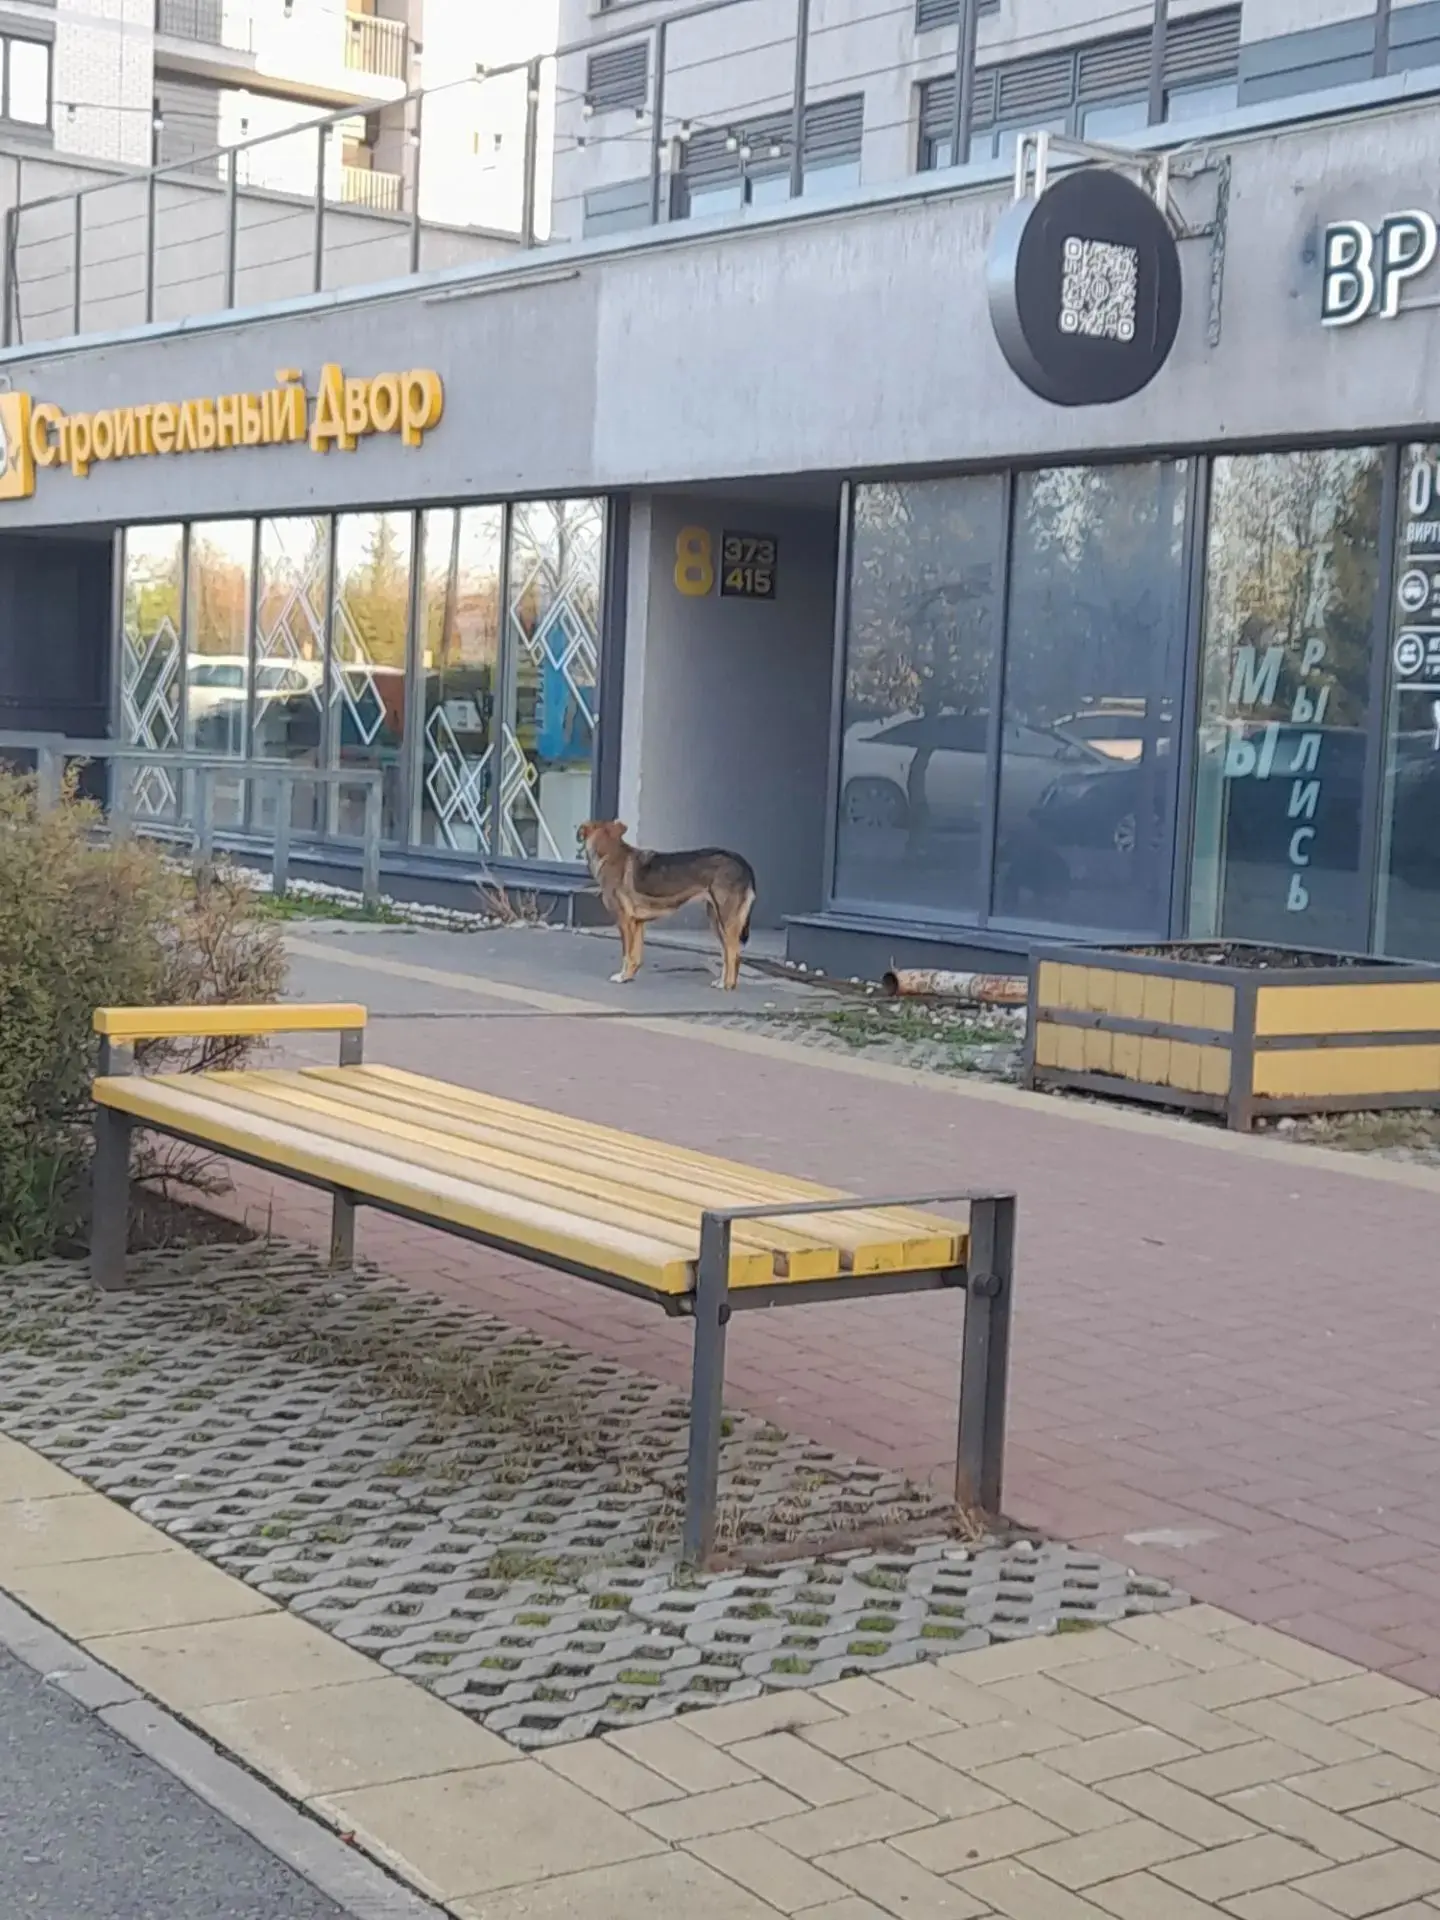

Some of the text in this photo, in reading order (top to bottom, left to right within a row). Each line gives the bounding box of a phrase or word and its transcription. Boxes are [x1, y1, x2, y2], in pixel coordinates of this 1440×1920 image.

[30, 363, 443, 477] Строительный Двор
[1406, 520, 1440, 544] ВИРТ
[673, 526, 713, 595] 8
[725, 536, 775, 564] 373
[725, 566, 772, 593] 415
